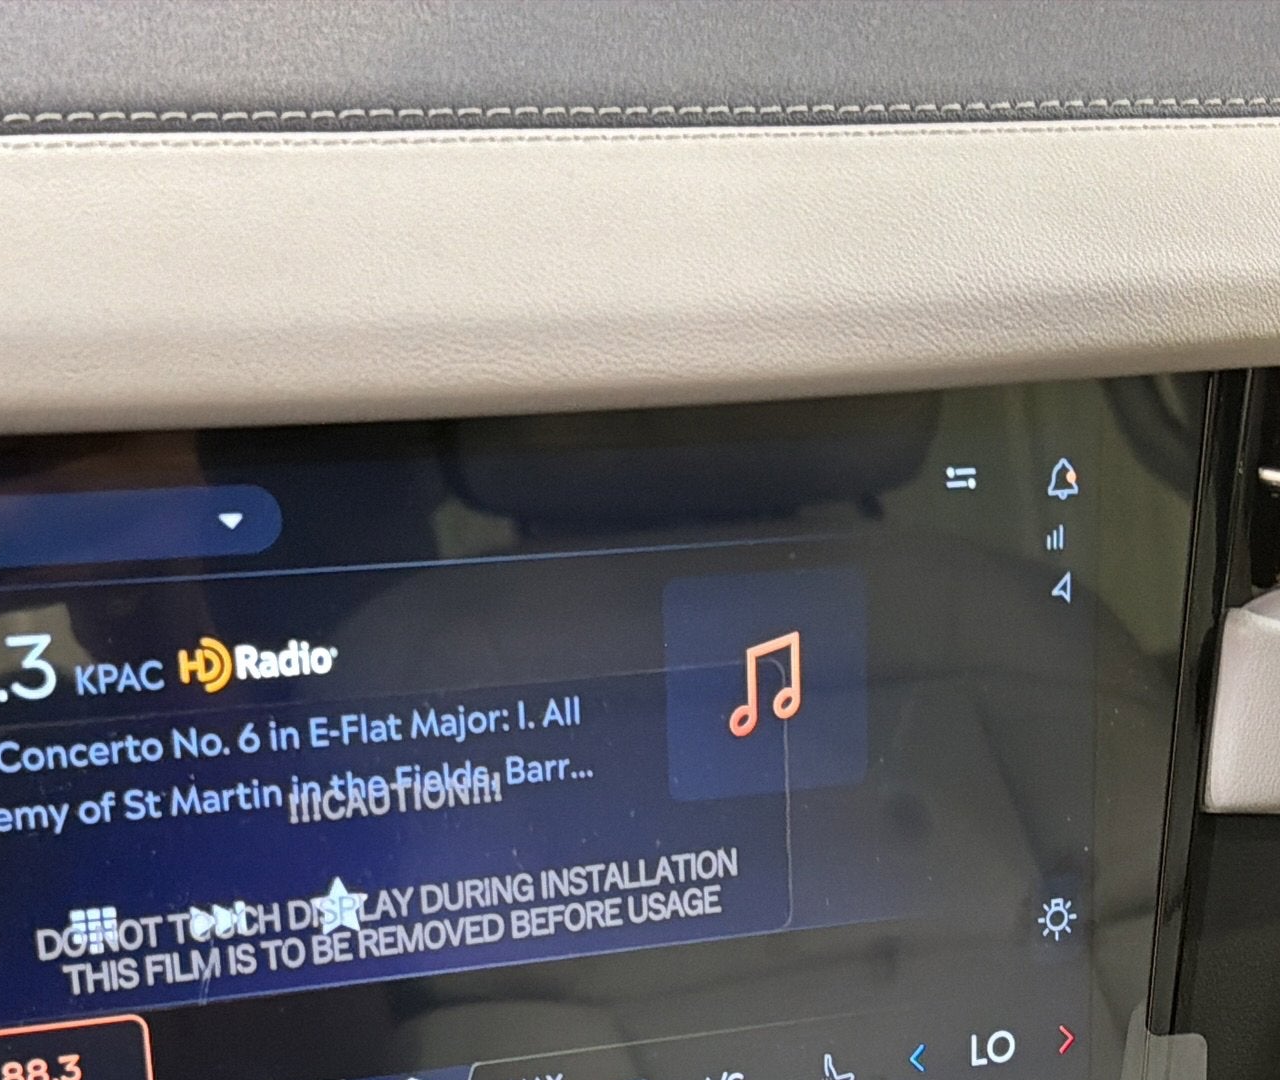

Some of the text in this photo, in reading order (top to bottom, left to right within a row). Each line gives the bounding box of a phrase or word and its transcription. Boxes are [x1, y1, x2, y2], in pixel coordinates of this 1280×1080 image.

[74, 660, 165, 696] KPAC
[177, 638, 231, 692] HD
[172, 727, 231, 760] No.
[238, 722, 261, 754] 6
[269, 720, 300, 752] in
[309, 713, 403, 749] E-Flat
[410, 705, 510, 743] Major:
[542, 695, 582, 729] All
[78, 790, 116, 826] of
[124, 788, 163, 821] St
[170, 779, 283, 817] Martin
[290, 775, 321, 807] in
[329, 771, 388, 801] the
[35, 847, 739, 962] DO NOT TOUCH DISPLAY DURING INSTALLATION
[62, 885, 722, 996] THIS FILM IS TO BE REMOVED BEFORE USAGE
[970, 1030, 1016, 1069] LO
